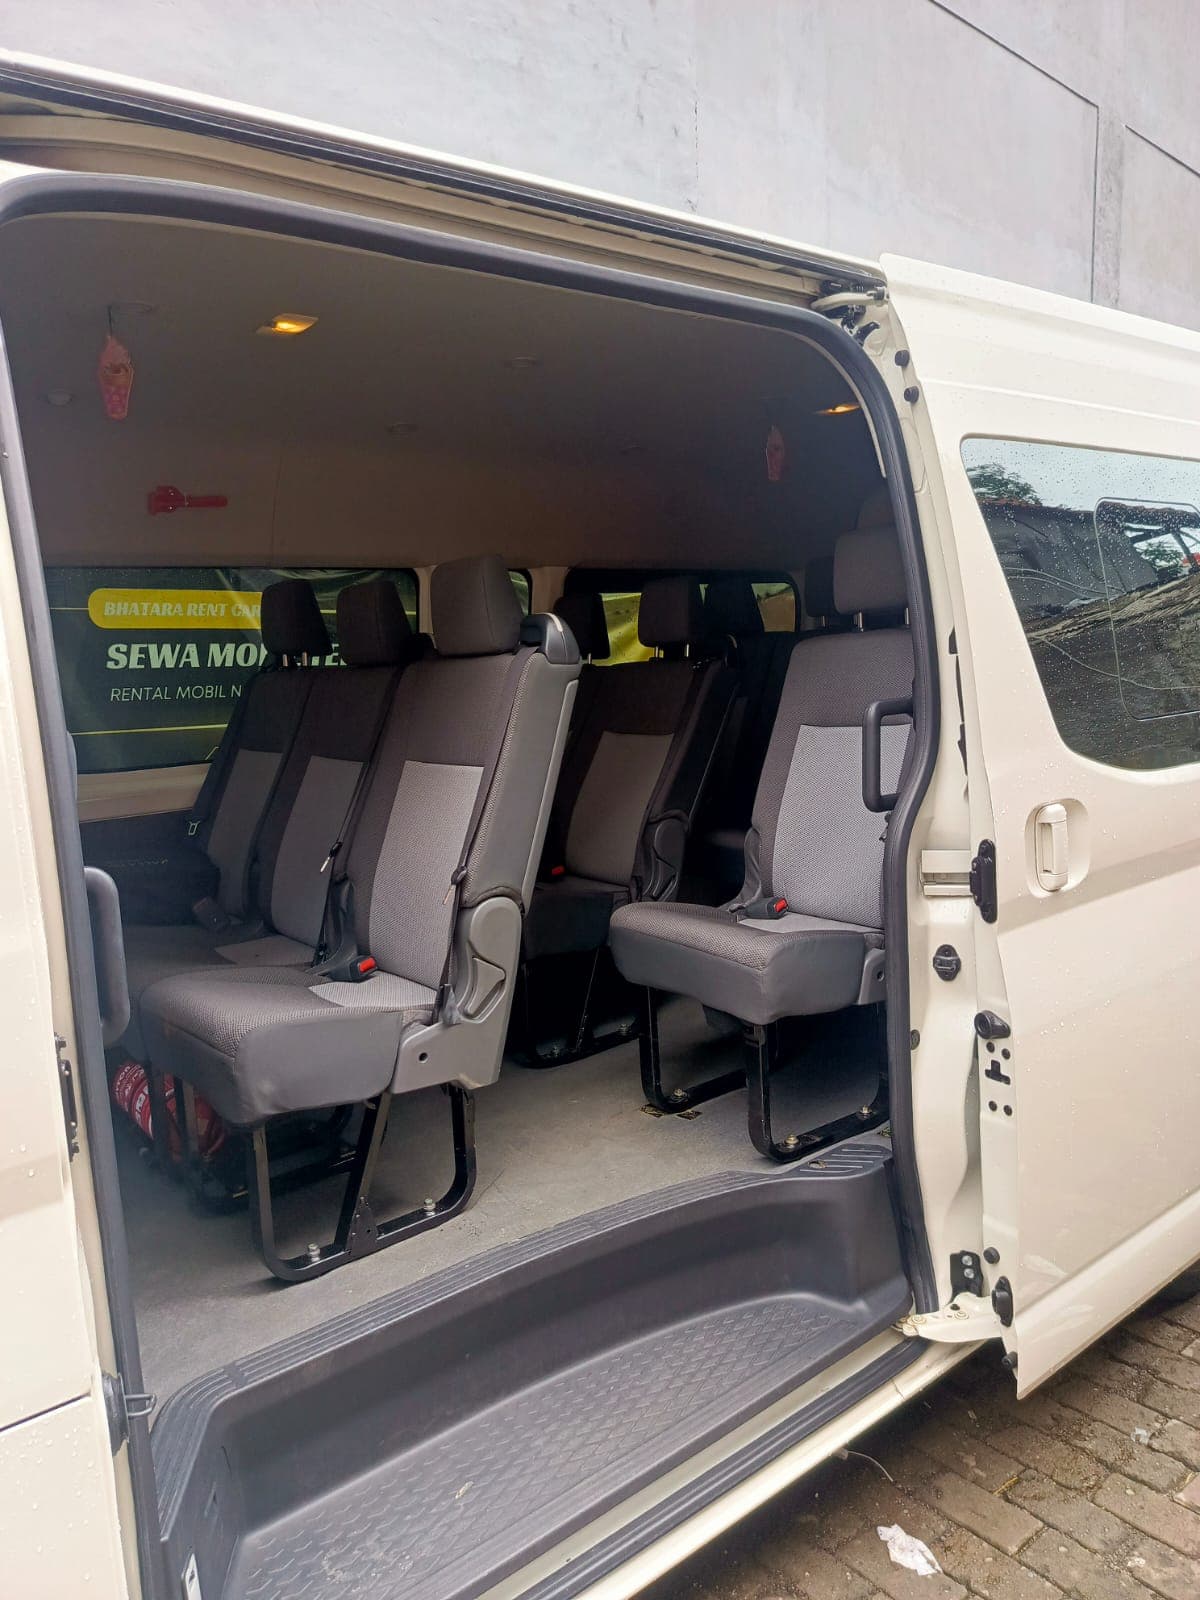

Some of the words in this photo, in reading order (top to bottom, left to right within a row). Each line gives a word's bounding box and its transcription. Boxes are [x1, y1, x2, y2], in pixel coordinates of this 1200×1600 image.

[104, 602, 183, 616] BHATARA
[186, 603, 227, 616] RENT
[106, 643, 200, 669] SEWA
[110, 687, 171, 701] RENTAL
[176, 685, 226, 699] MOBIL
